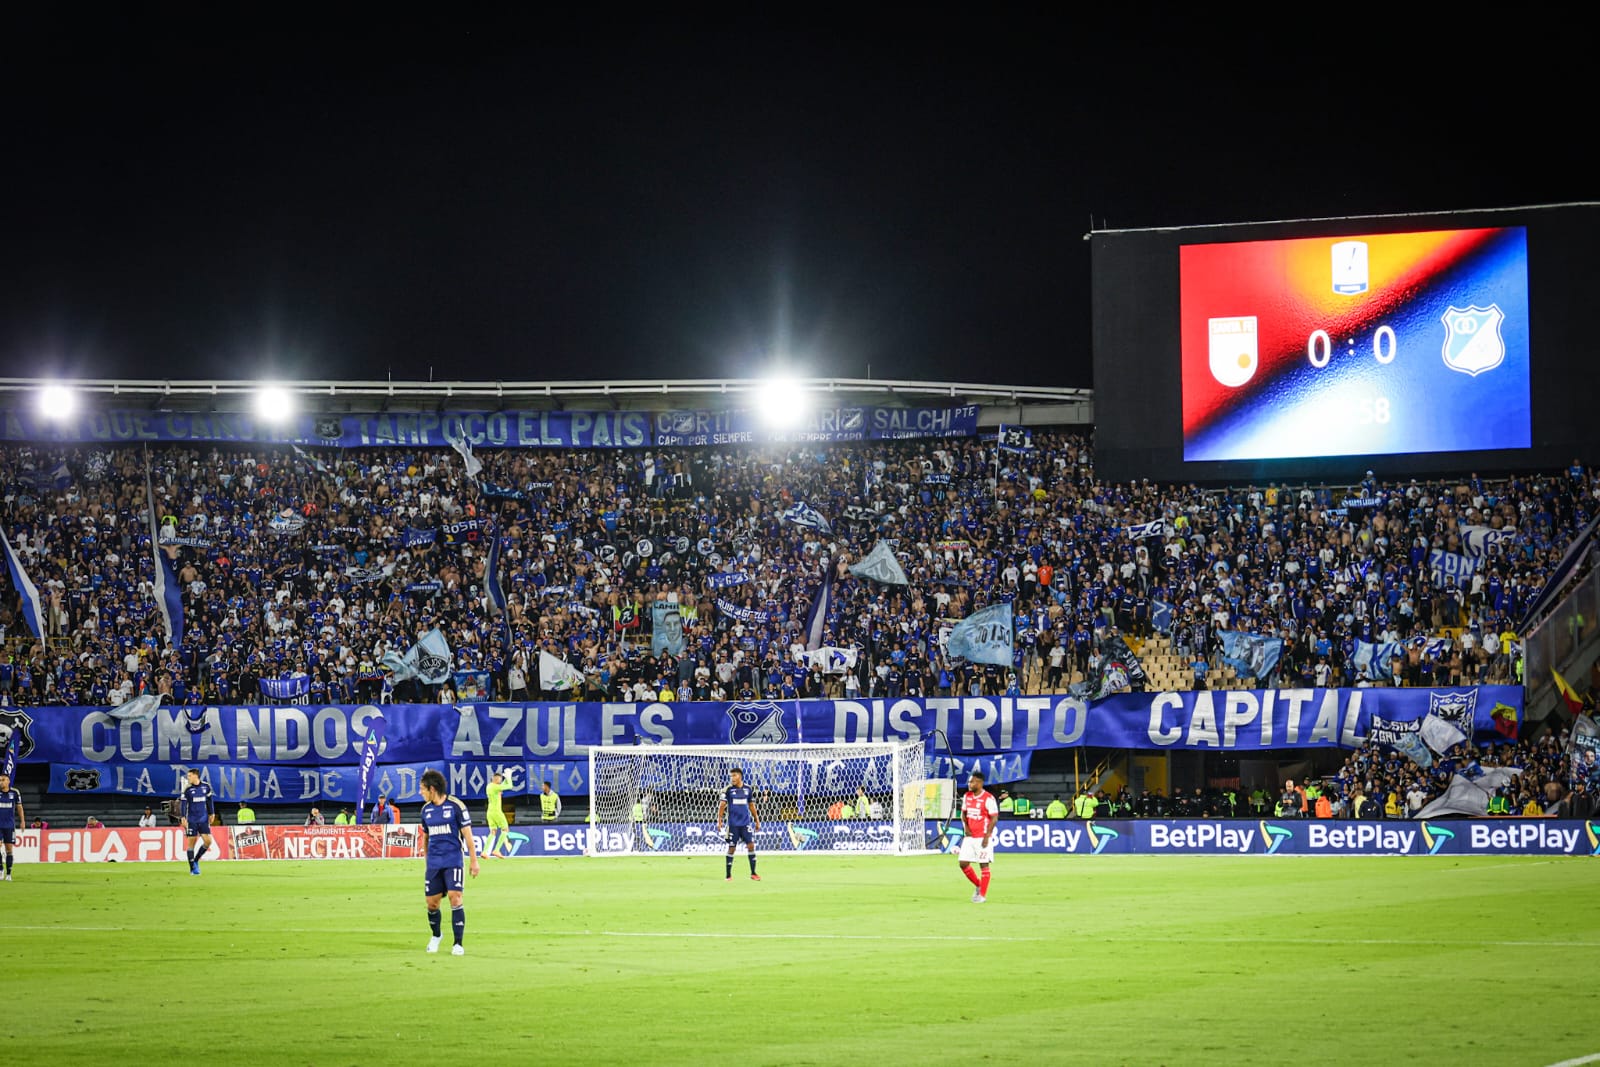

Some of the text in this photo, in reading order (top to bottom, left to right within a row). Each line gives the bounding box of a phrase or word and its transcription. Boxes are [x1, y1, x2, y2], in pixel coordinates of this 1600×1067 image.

[1308, 329, 1331, 367] 0
[1373, 326, 1396, 363] 0
[874, 408, 951, 431] SALCHI
[954, 406, 976, 418] PTE
[358, 412, 508, 445] TAMPOCO
[519, 412, 563, 445] EL
[572, 413, 644, 446] PAIS
[689, 434, 707, 445] POR
[713, 431, 753, 444] SIEMPRE
[80, 705, 388, 762] COMANDOS
[452, 702, 674, 757] AZULES
[832, 696, 1088, 751] DISTRITO
[1147, 688, 1368, 748] CAPITAL
[116, 766, 156, 794] LA
[299, 770, 345, 799] DE
[237, 836, 265, 848] NECTAR
[303, 827, 346, 836] AGUARDIENTE
[387, 837, 414, 848] NECTAR
[543, 826, 636, 854] BetPlay
[1150, 823, 1255, 852] BetPlay
[1308, 823, 1416, 853] BetPlay
[1471, 823, 1580, 853] BetPlay
[48, 830, 127, 863] FILA
[284, 836, 366, 859] NECTAR
[453, 867, 462, 882] 11
